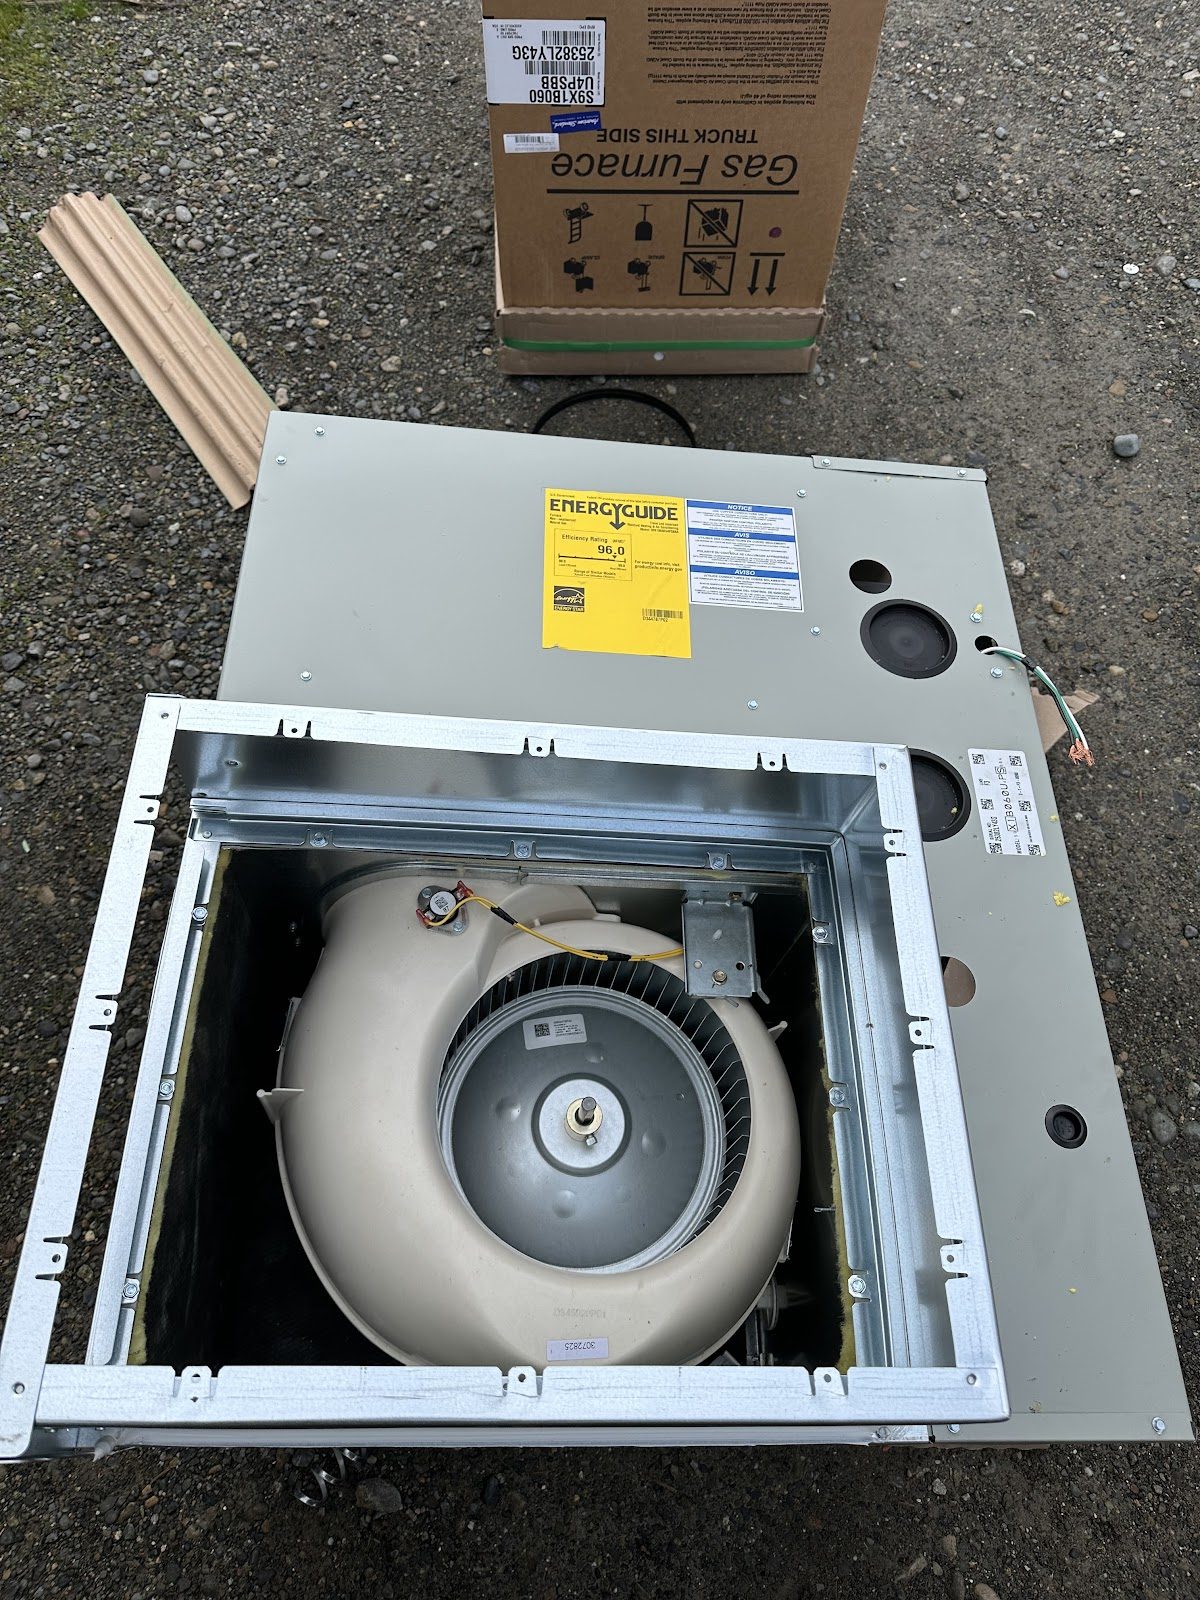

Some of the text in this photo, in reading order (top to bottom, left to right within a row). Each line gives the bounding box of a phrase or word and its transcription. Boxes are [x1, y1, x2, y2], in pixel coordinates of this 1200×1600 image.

[512, 46, 594, 60] 25382LY43G
[541, 76, 594, 90] U4PSBB
[530, 89, 594, 103] S9X1B060
[596, 128, 758, 144] TRUCK THIS SIDE
[551, 153, 798, 186] Gas Furnace
[550, 498, 679, 522] ENERGYGUIDE
[598, 545, 625, 555] 96.0
[564, 1342, 595, 1351] 3072825
